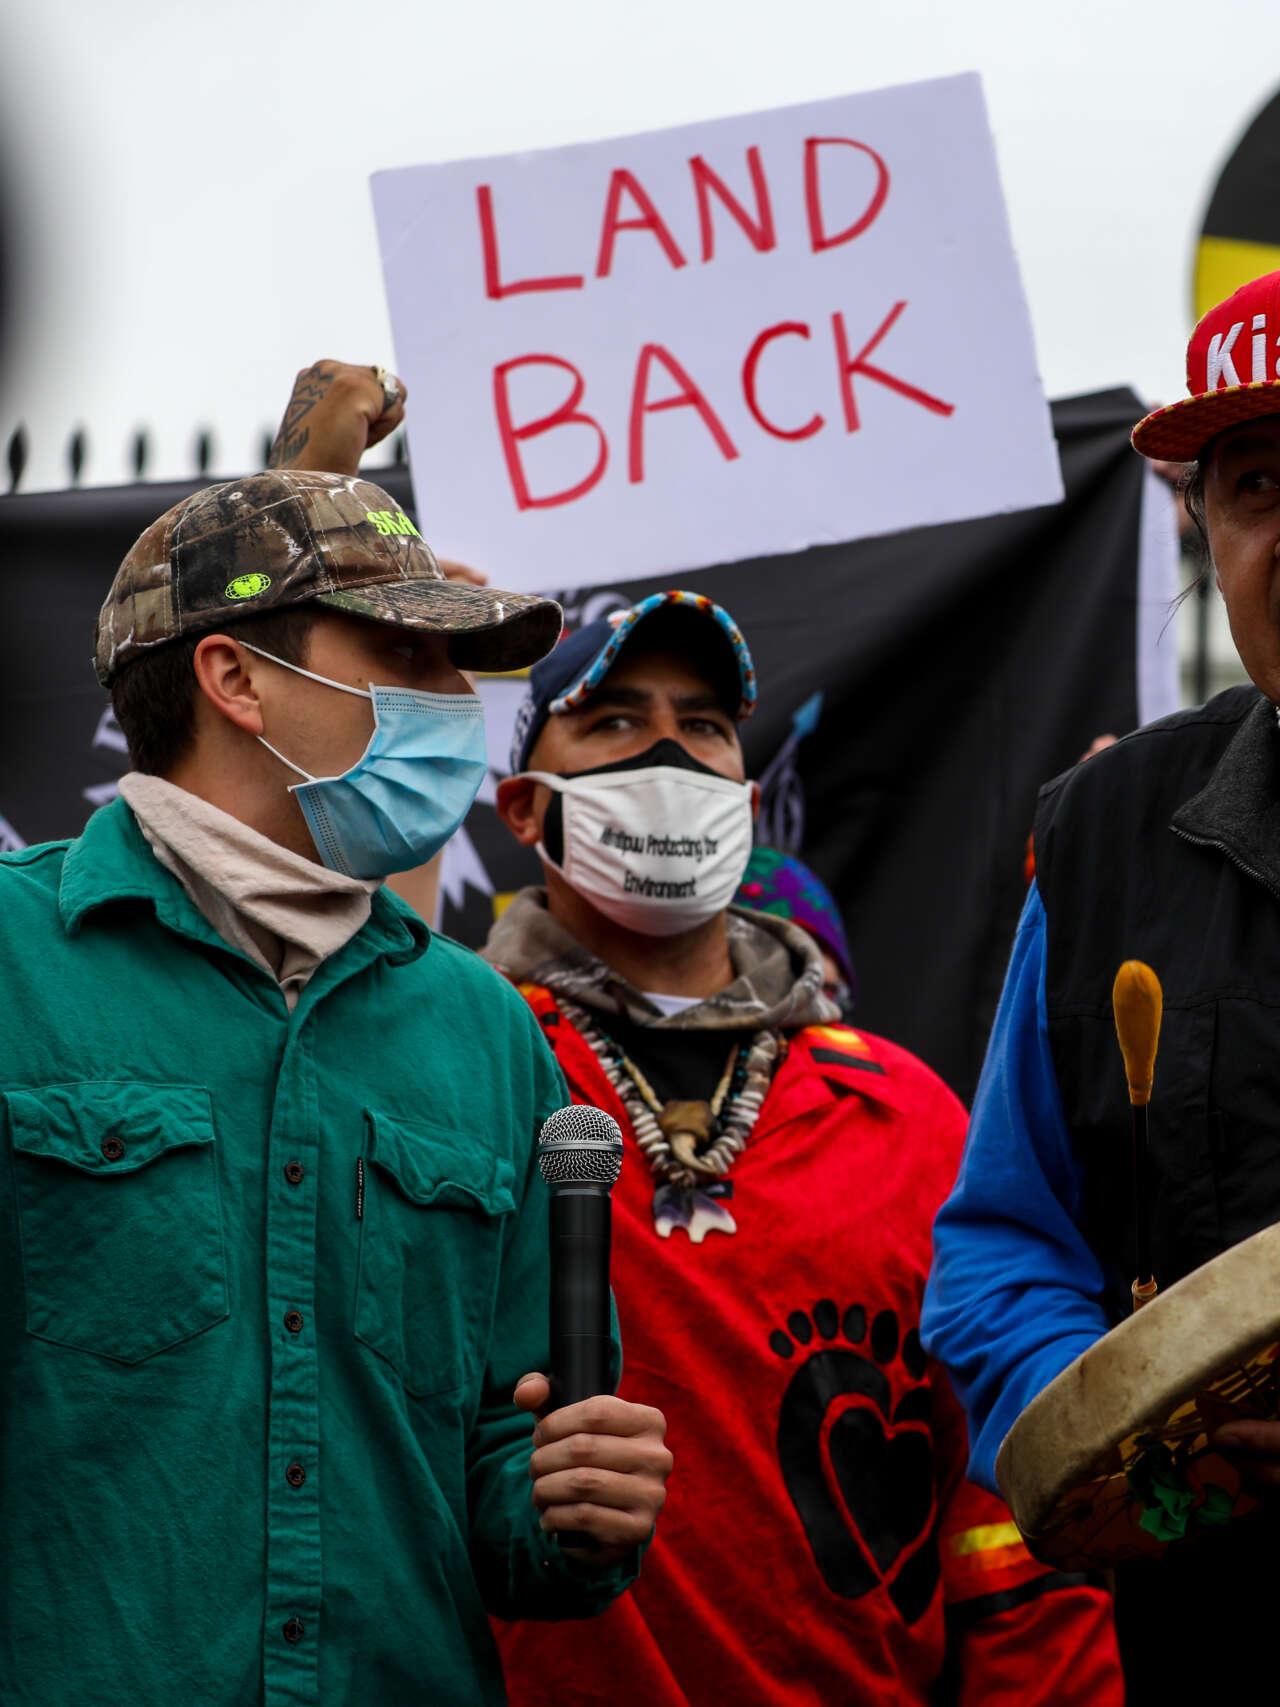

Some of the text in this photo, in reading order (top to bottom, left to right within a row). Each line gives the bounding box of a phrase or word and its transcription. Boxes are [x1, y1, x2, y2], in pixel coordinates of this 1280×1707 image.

[476, 136, 890, 300] LAND
[493, 300, 955, 512] BACK
[623, 868, 697, 899] Environment
